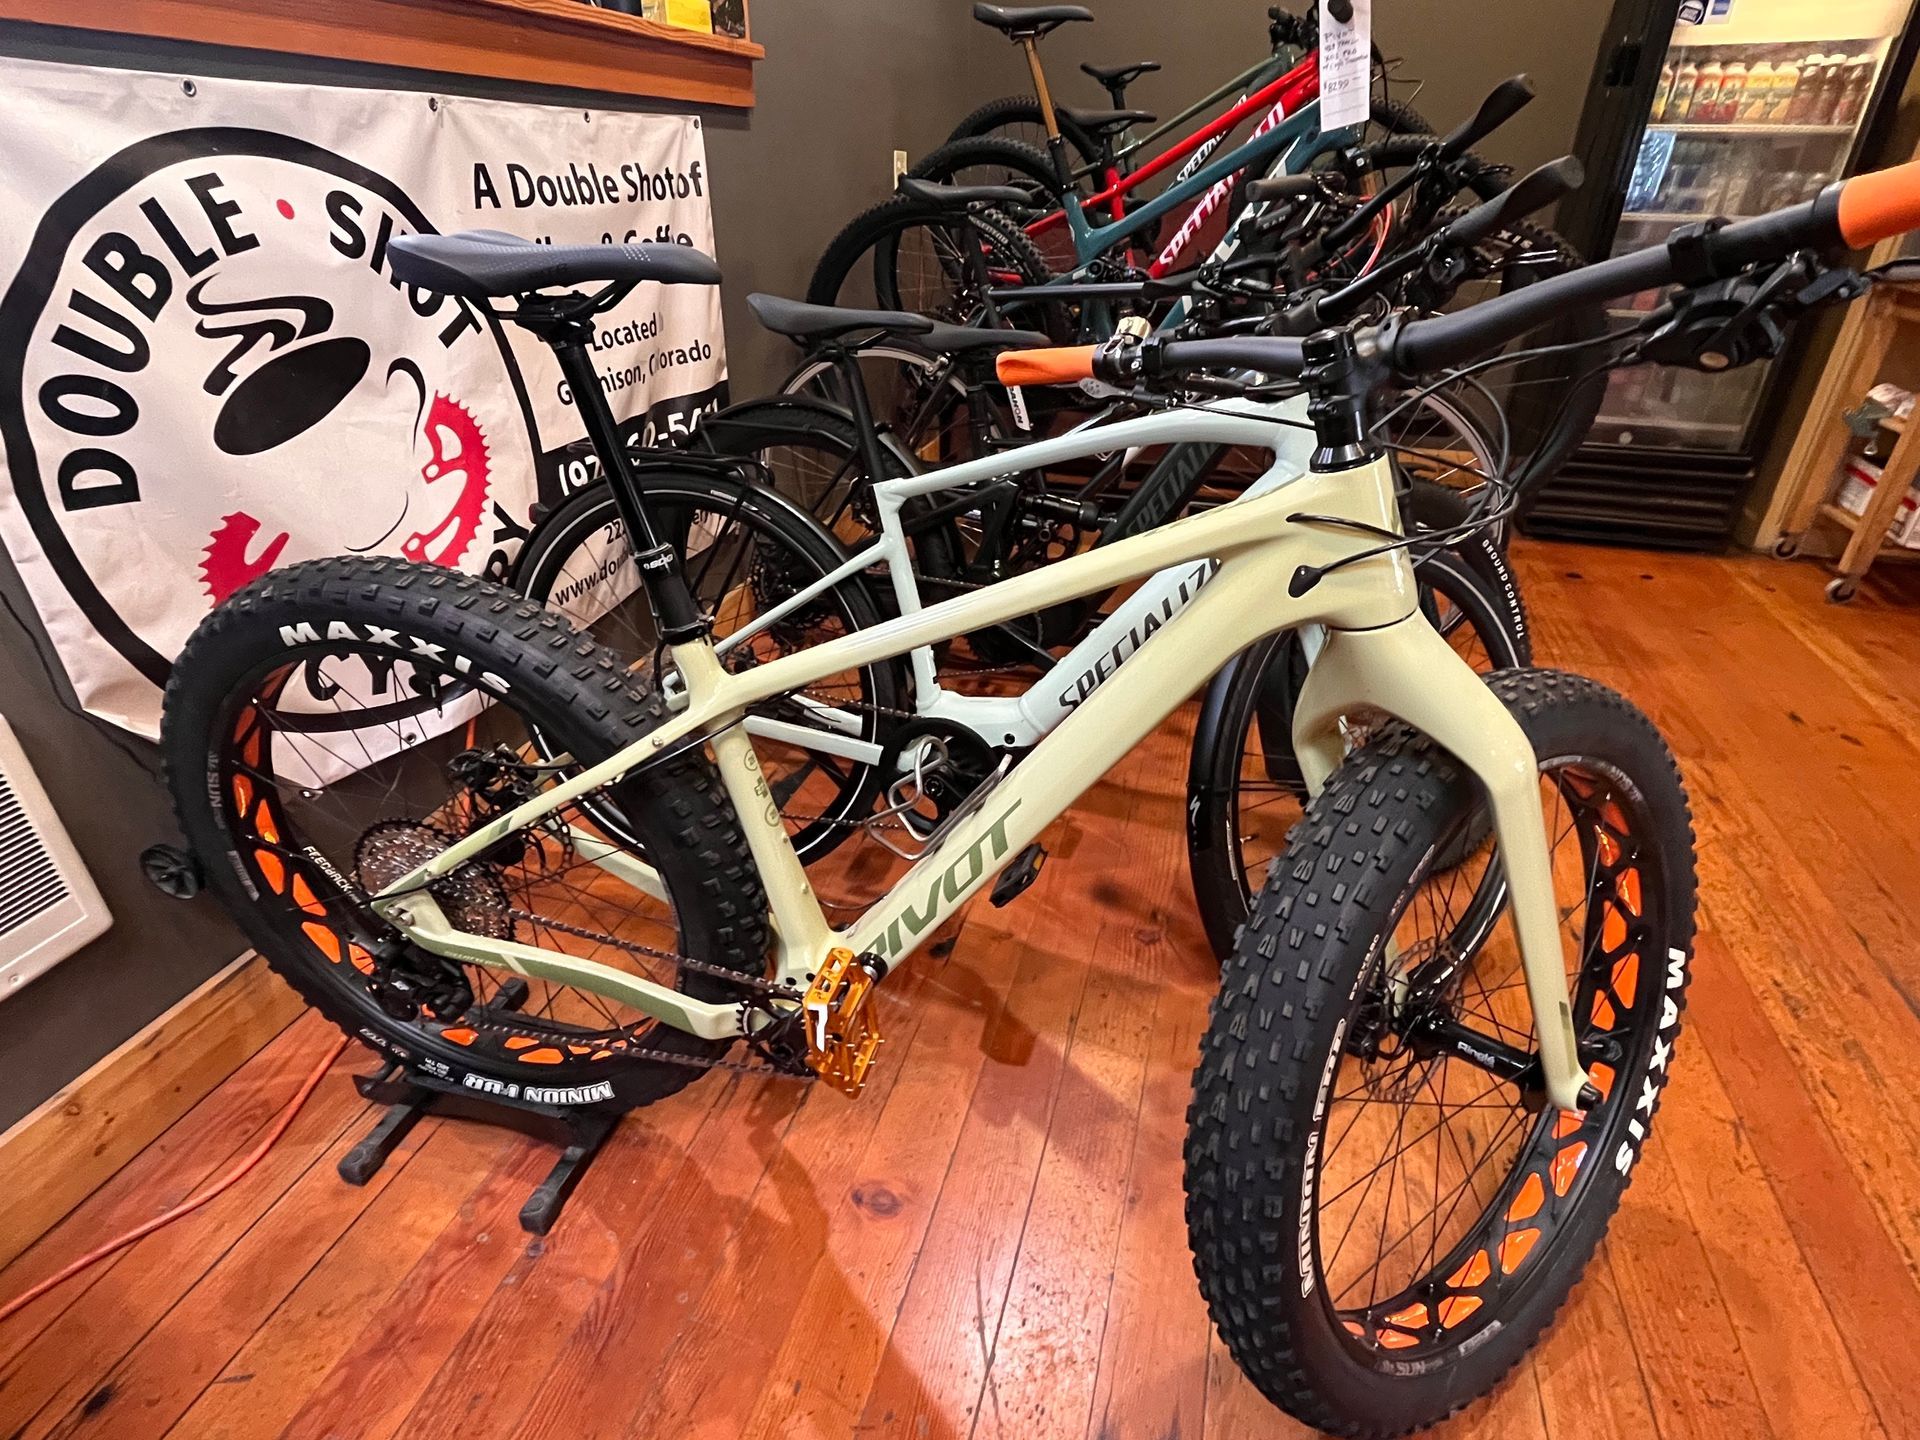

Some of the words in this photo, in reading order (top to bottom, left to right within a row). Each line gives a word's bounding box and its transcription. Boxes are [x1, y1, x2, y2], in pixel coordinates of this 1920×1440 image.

[474, 163, 501, 210] A
[507, 163, 619, 209] Double
[39, 173, 261, 512] DOUBLE
[593, 313, 657, 352] Located
[557, 366, 646, 406] Gnison,
[1482, 539, 1509, 581] GROUND
[1504, 583, 1525, 639] CONTROL
[279, 621, 511, 694] MAXXIS
[863, 798, 1022, 958] PIVOT
[523, 1080, 616, 1106] MINION
[1615, 947, 1686, 1177] MAXXIS
[1299, 1132, 1321, 1299] MINION
